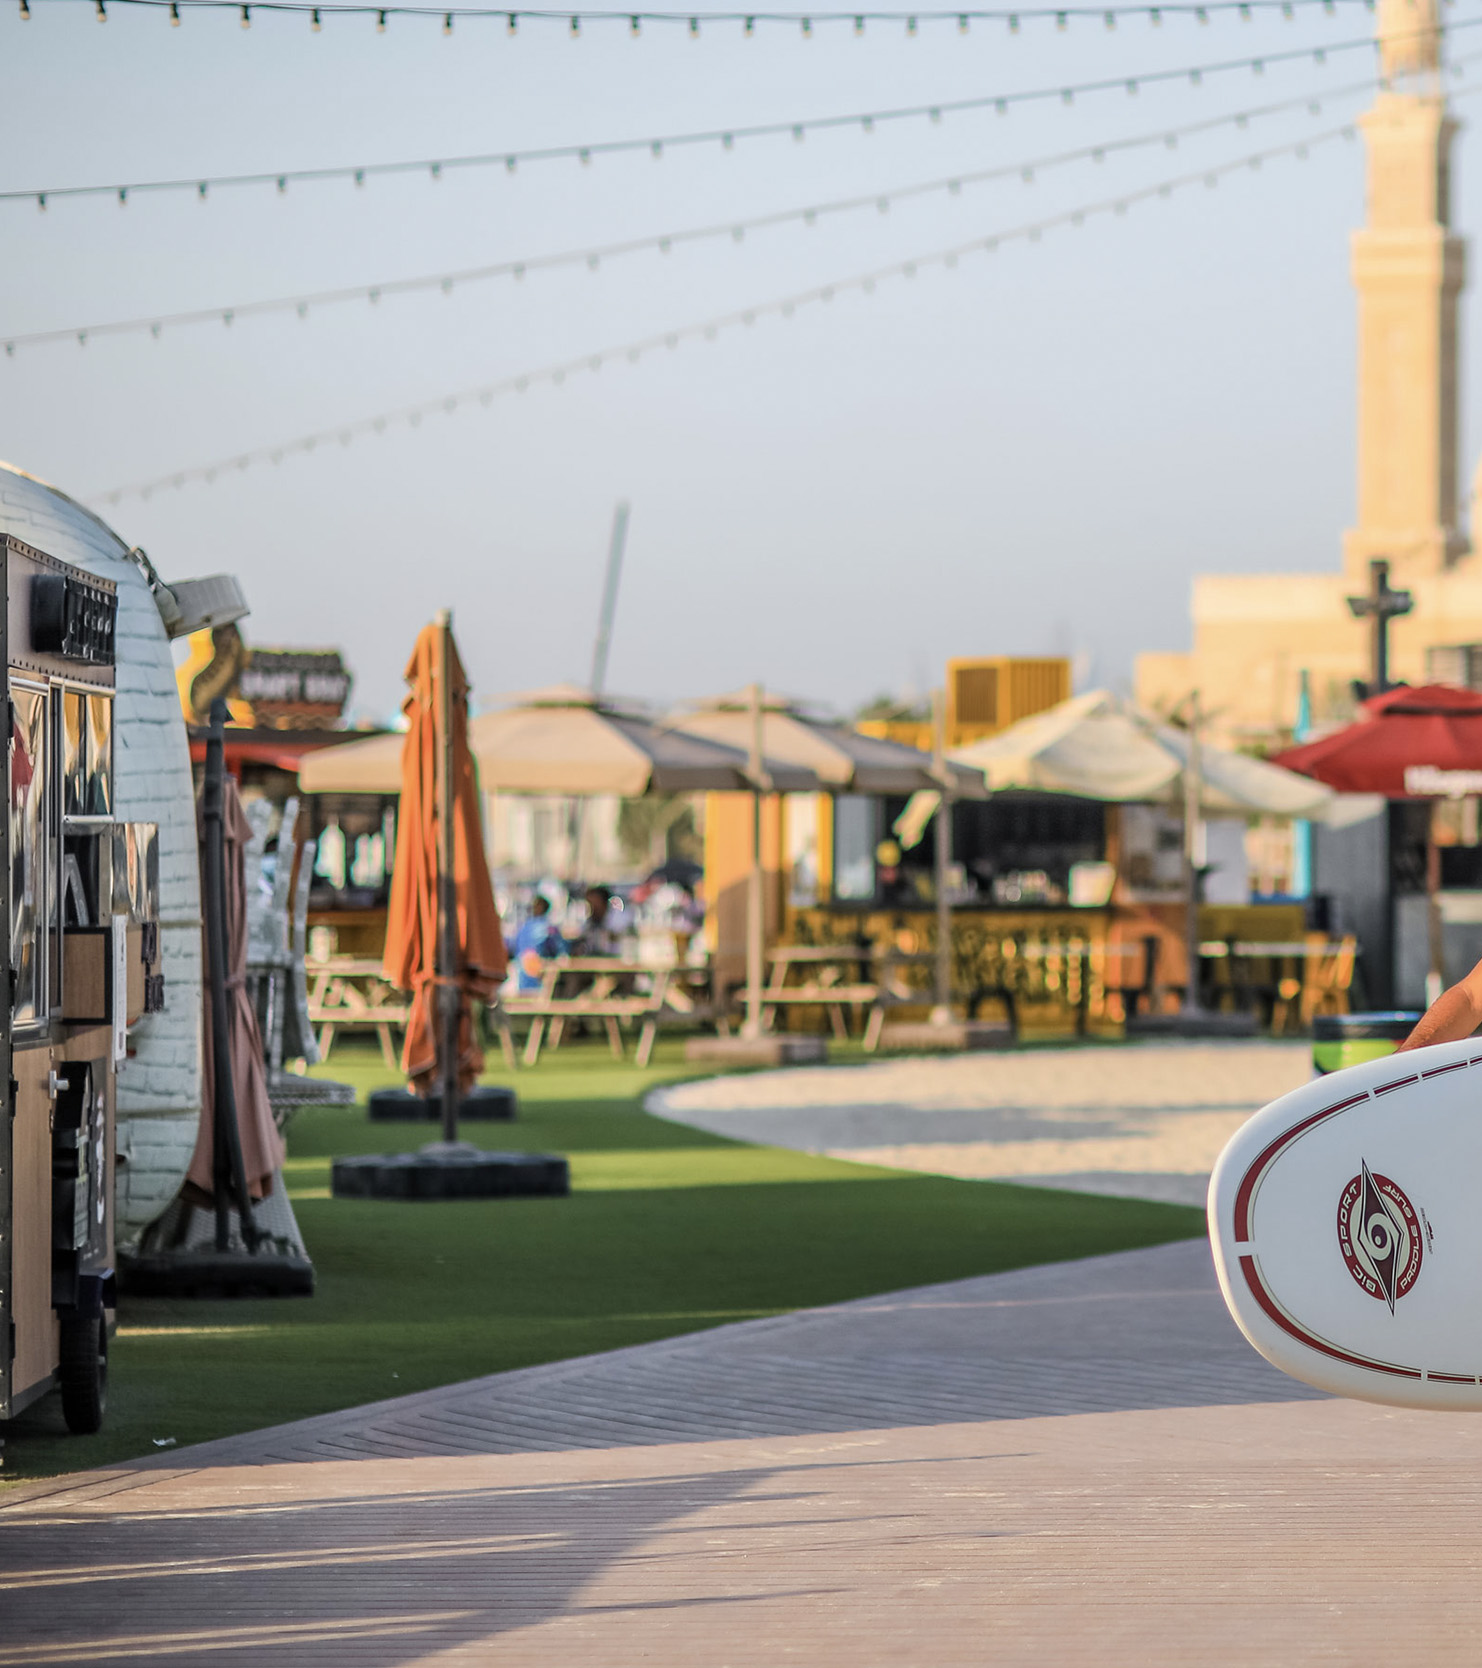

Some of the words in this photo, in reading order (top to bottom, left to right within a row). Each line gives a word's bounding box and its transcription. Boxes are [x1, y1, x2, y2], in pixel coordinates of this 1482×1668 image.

[1340, 1183, 1358, 1257] SPORT
[1382, 1185, 1413, 1219] SURF
[1400, 1225, 1420, 1290] PADDLE
